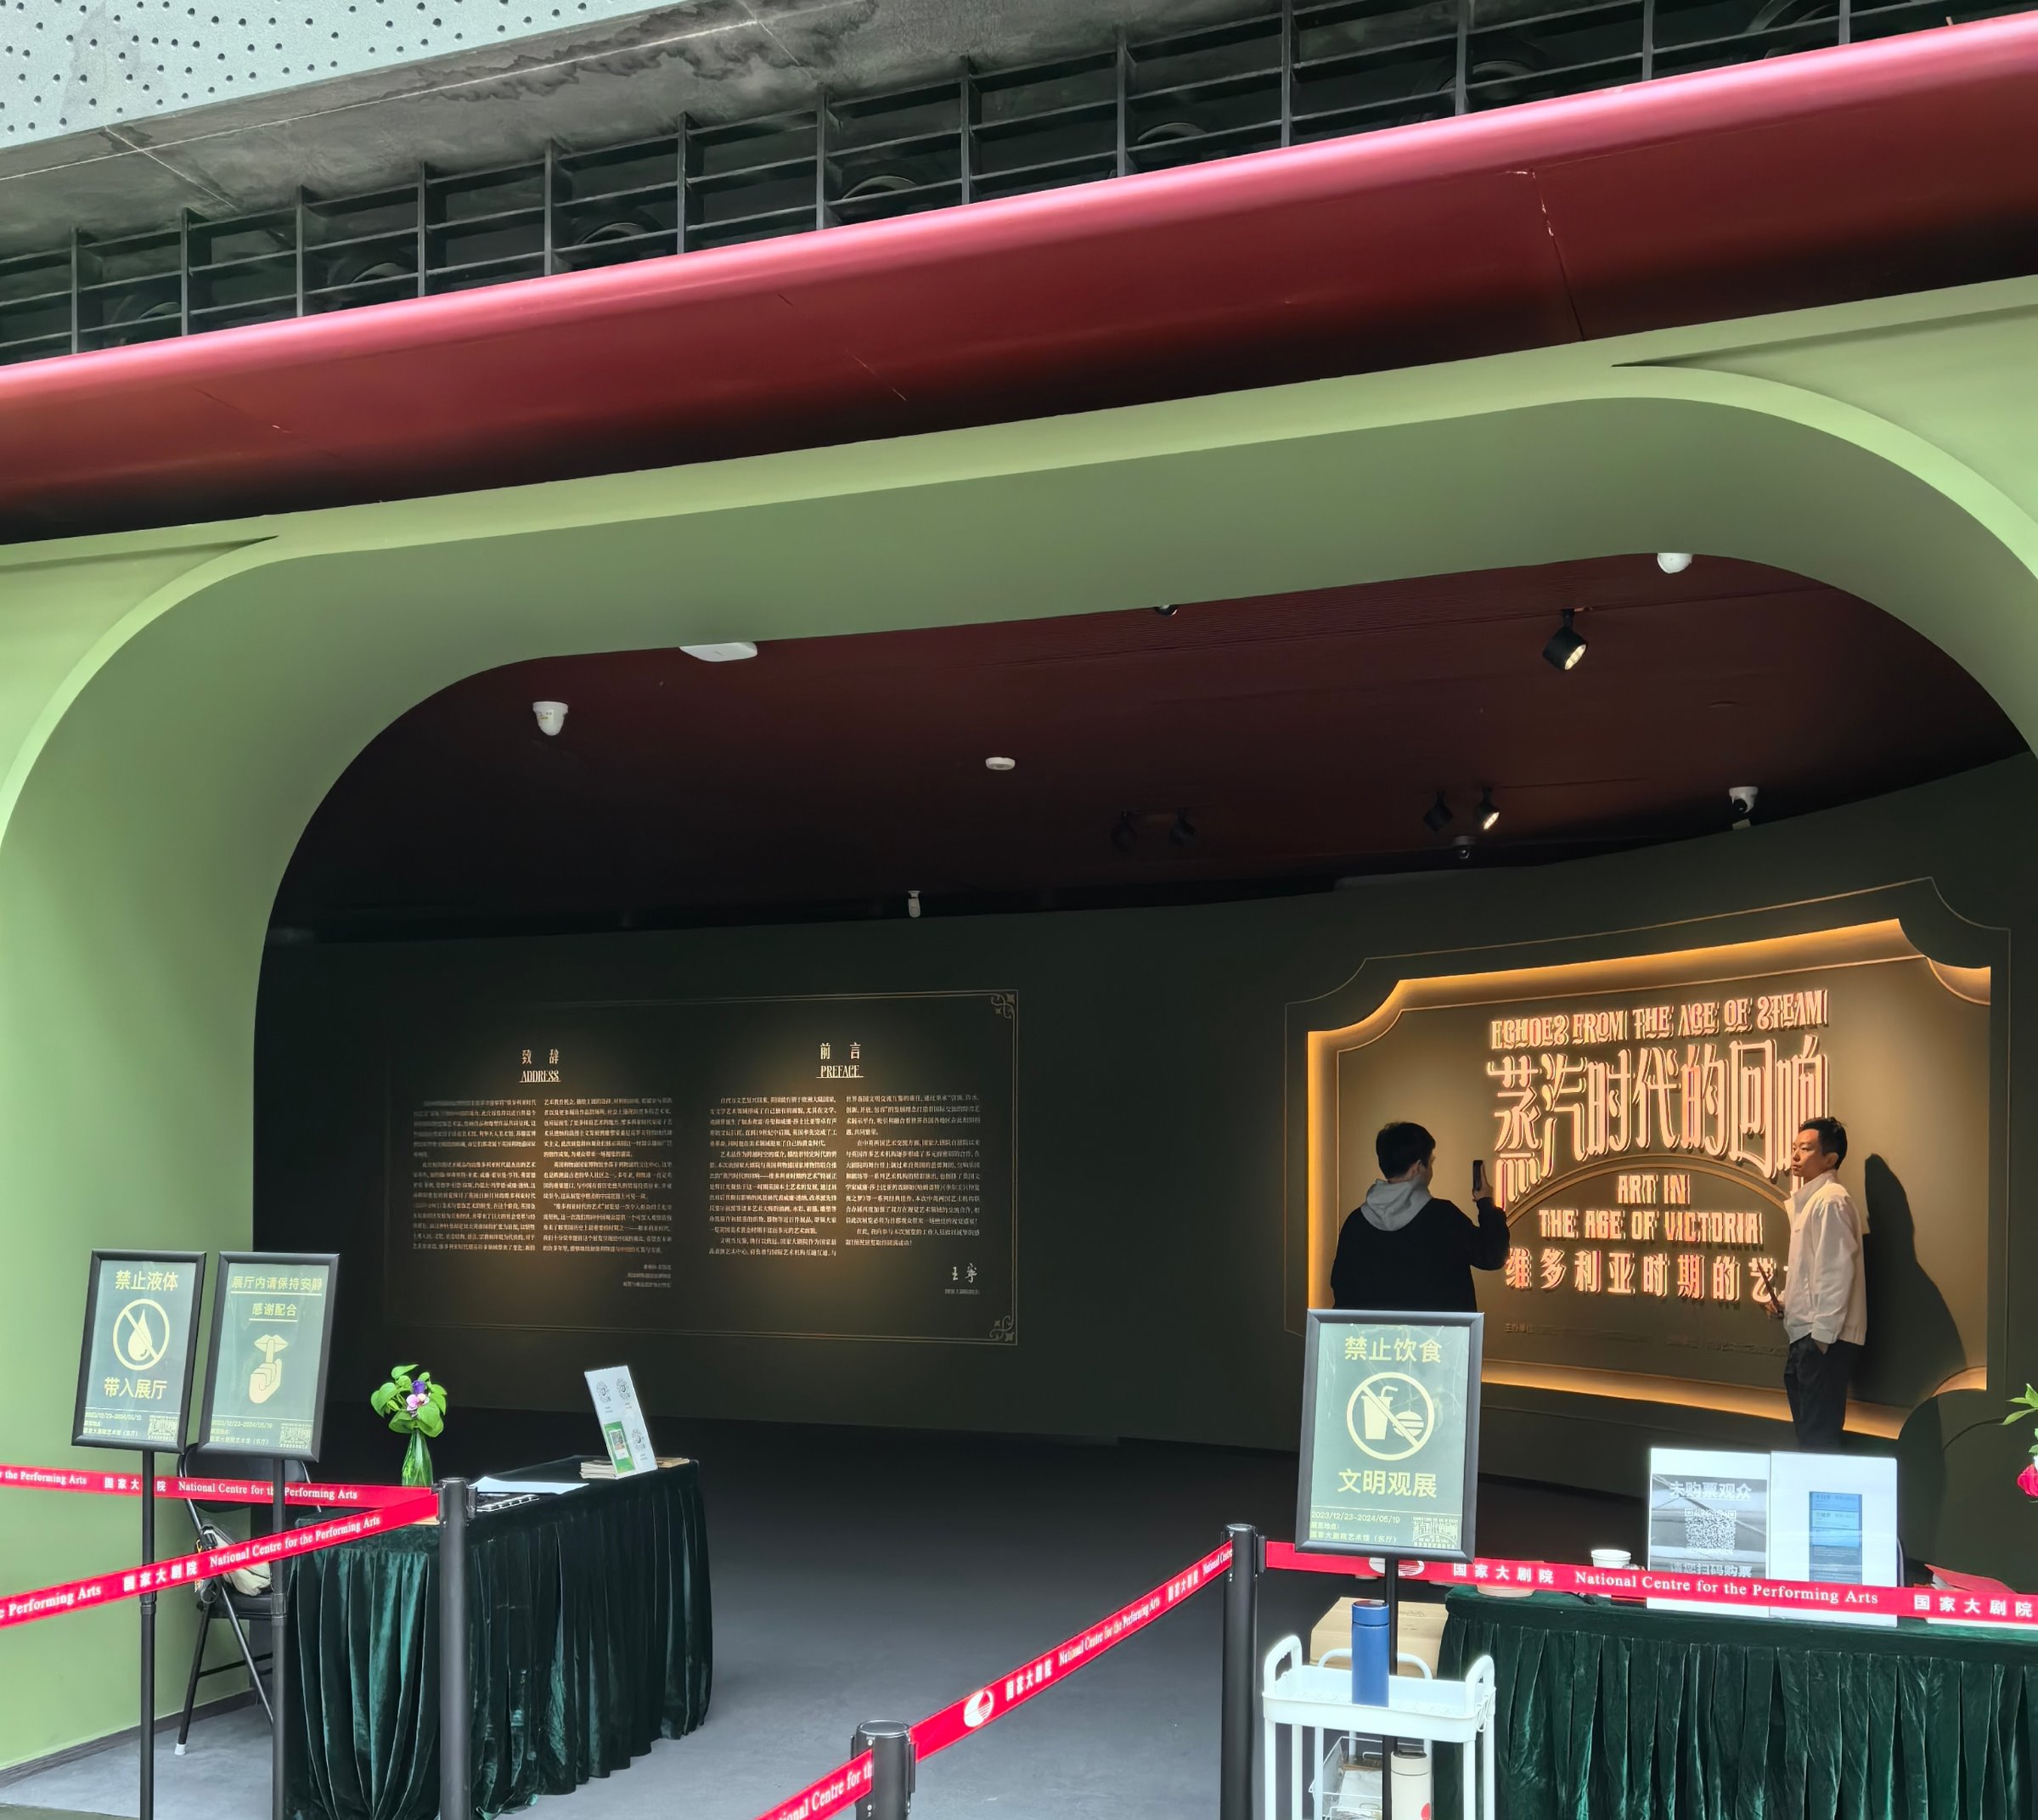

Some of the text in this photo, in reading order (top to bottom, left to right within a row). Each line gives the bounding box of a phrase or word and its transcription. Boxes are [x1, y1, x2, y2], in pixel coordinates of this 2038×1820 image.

[1491, 989, 1827, 1050] ECHOES FROM THE AGE OF STEAM
[820, 1042, 861, 1060] 前言
[521, 1070, 560, 1083] ADDRESS
[820, 1065, 860, 1078] PREFACE
[1487, 1034, 1828, 1210] 蒸汽时代的回响
[1618, 1174, 1691, 1205] ART IN
[1539, 1210, 1763, 1245] THE AGE OF VICTORIA
[115, 1271, 178, 1292] 禁止液体
[232, 1276, 323, 1293] 展厅内请保持安静
[1506, 1248, 1789, 1304] 维多利亚时期的艺
[252, 1303, 297, 1317] 感谢配合
[1345, 1336, 1442, 1364] 禁止饮食
[104, 1377, 167, 1400] 带入展厅
[5, 1470, 18, 1480] the
[20, 1471, 66, 1485] Performing
[69, 1474, 87, 1485] Arts
[104, 1477, 166, 1491] 国家大院
[1337, 1468, 1437, 1499] 文明观展
[178, 1481, 215, 1493] National
[218, 1483, 247, 1494] Centre
[251, 1485, 263, 1495] for
[284, 1486, 335, 1500] Performing
[337, 1489, 357, 1500] Arts
[1669, 1481, 1752, 1500] 未购票观众
[210, 1516, 380, 1568] National Centre for the Performing Arts
[123, 1561, 197, 1592] 国家大剧院
[1454, 1563, 1554, 1584] 国家大剧院
[1575, 1571, 1878, 1604] National Centre for the Performing Arts
[8, 1592, 74, 1616] Performing
[77, 1585, 102, 1600] Arts
[1914, 1593, 2033, 1618] 国家大剧院
[811, 1781, 844, 1811] Centre
[847, 1770, 861, 1790] for
